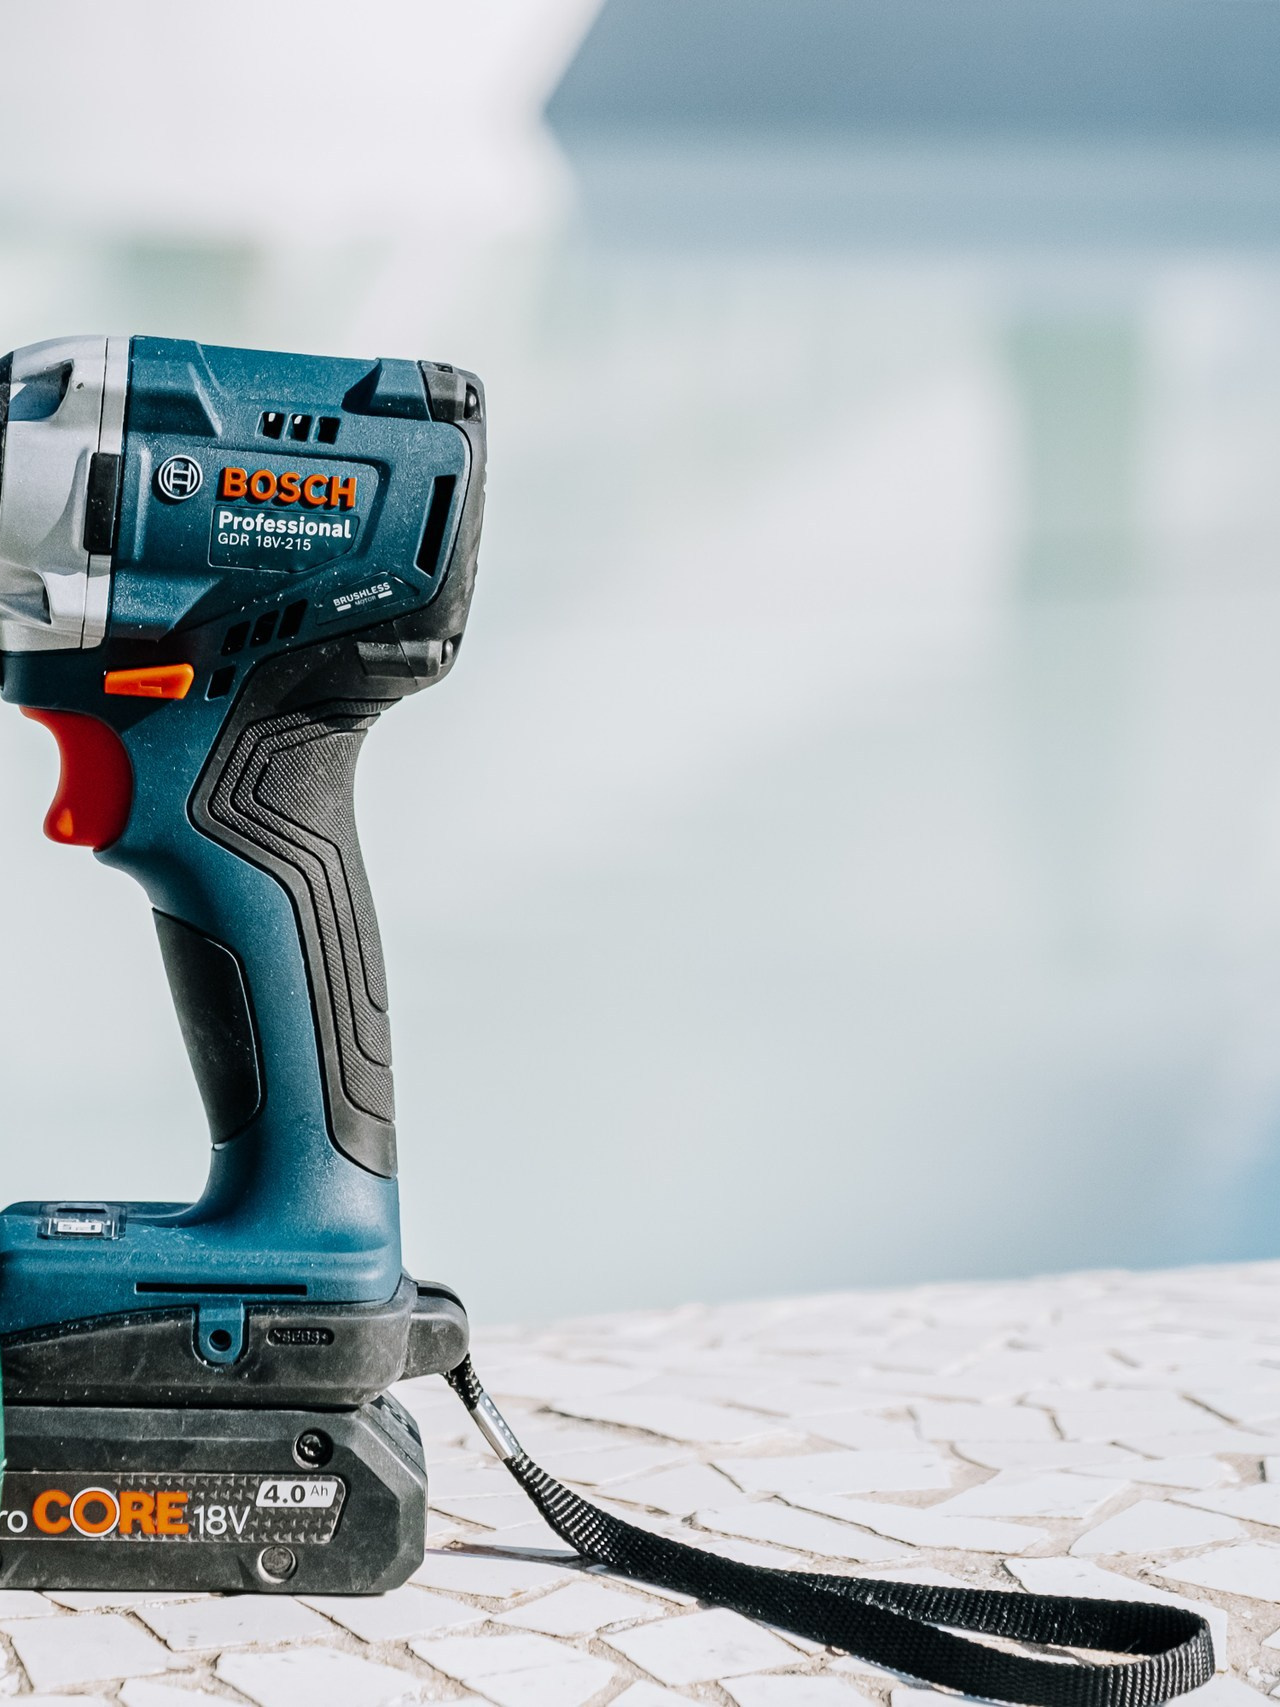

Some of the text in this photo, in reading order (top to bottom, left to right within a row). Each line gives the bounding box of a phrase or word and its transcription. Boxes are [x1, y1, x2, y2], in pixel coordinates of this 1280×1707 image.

[223, 467, 357, 507] BOSCH
[218, 511, 352, 539] Professional
[217, 532, 312, 551] GDR 18V-215
[333, 582, 391, 606] BRUSHLESS
[263, 1484, 329, 1504] 4.0 Ah
[32, 1486, 189, 1538] CORE
[193, 1505, 251, 1535] 18V
